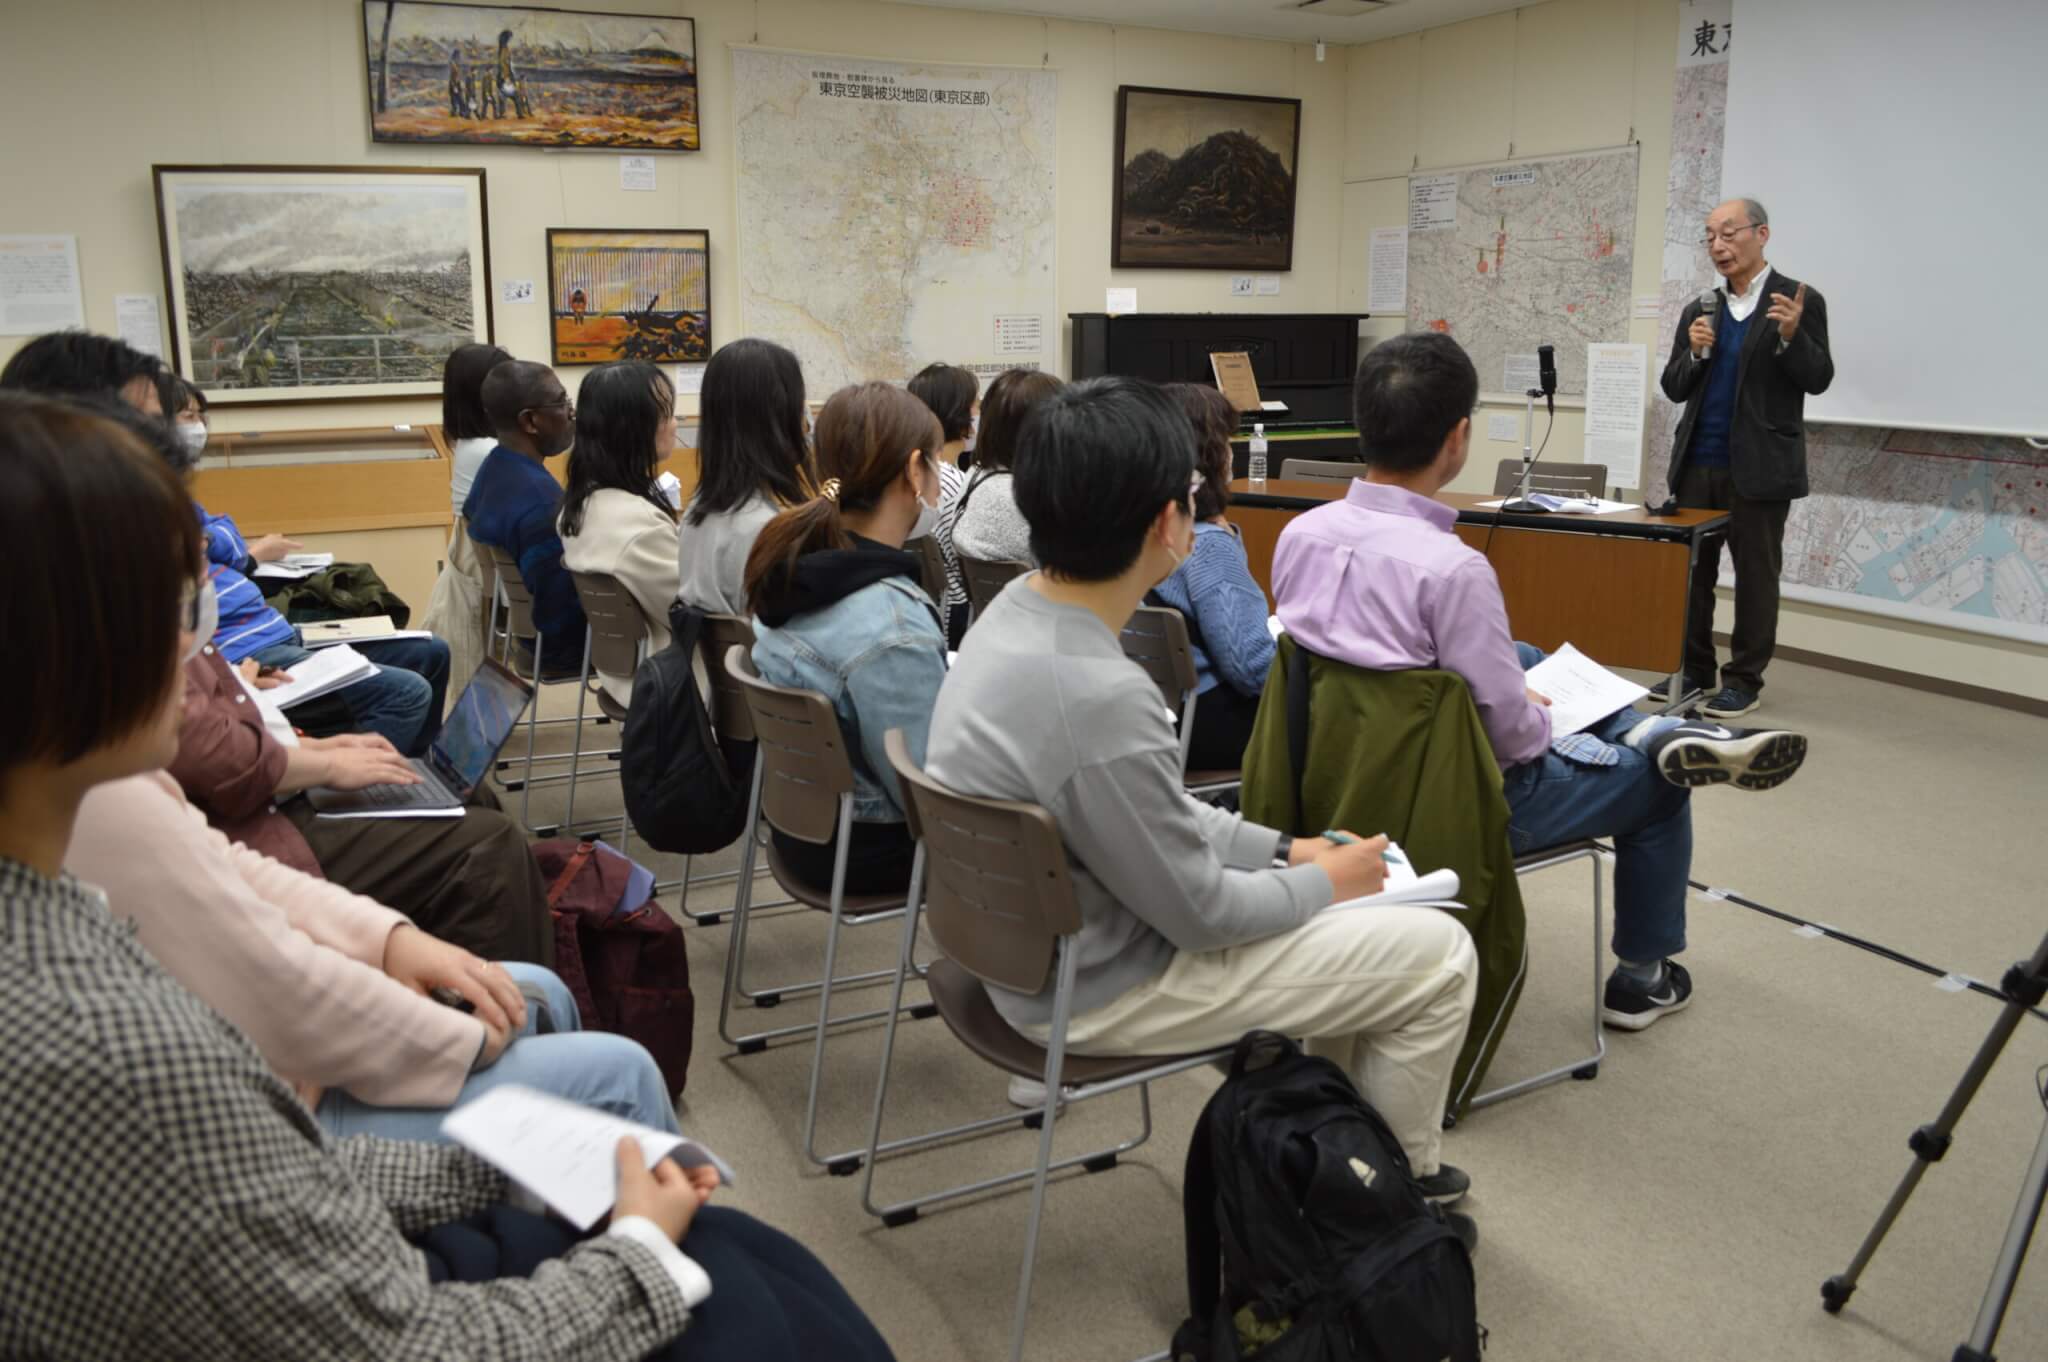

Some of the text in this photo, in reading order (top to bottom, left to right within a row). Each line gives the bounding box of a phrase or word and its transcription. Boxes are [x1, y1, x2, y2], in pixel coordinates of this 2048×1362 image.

[819, 81, 990, 105] 東京空襲被災地図(東京区部)
